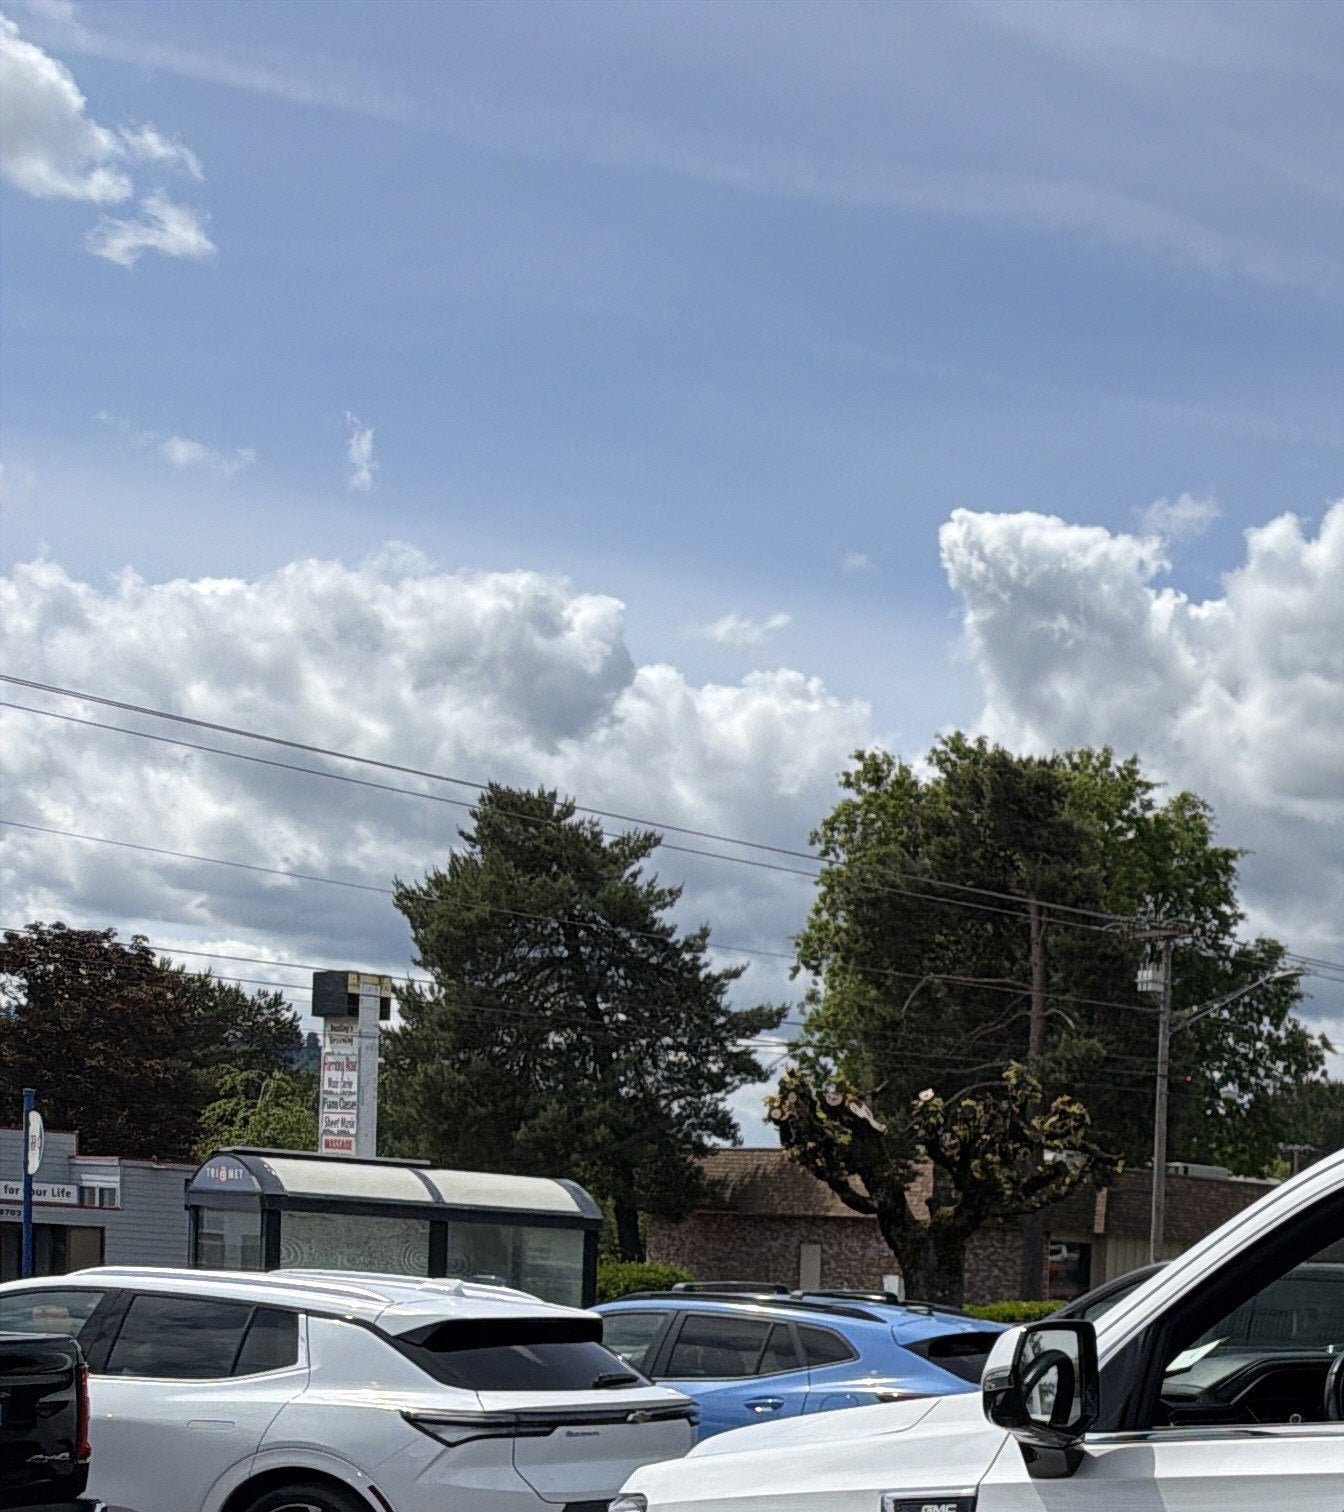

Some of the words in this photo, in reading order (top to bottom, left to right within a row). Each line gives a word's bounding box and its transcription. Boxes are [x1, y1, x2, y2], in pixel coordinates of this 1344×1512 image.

[228, 1168, 243, 1180] MET
[3, 1184, 20, 1196] for
[51, 1187, 71, 1198] Life
